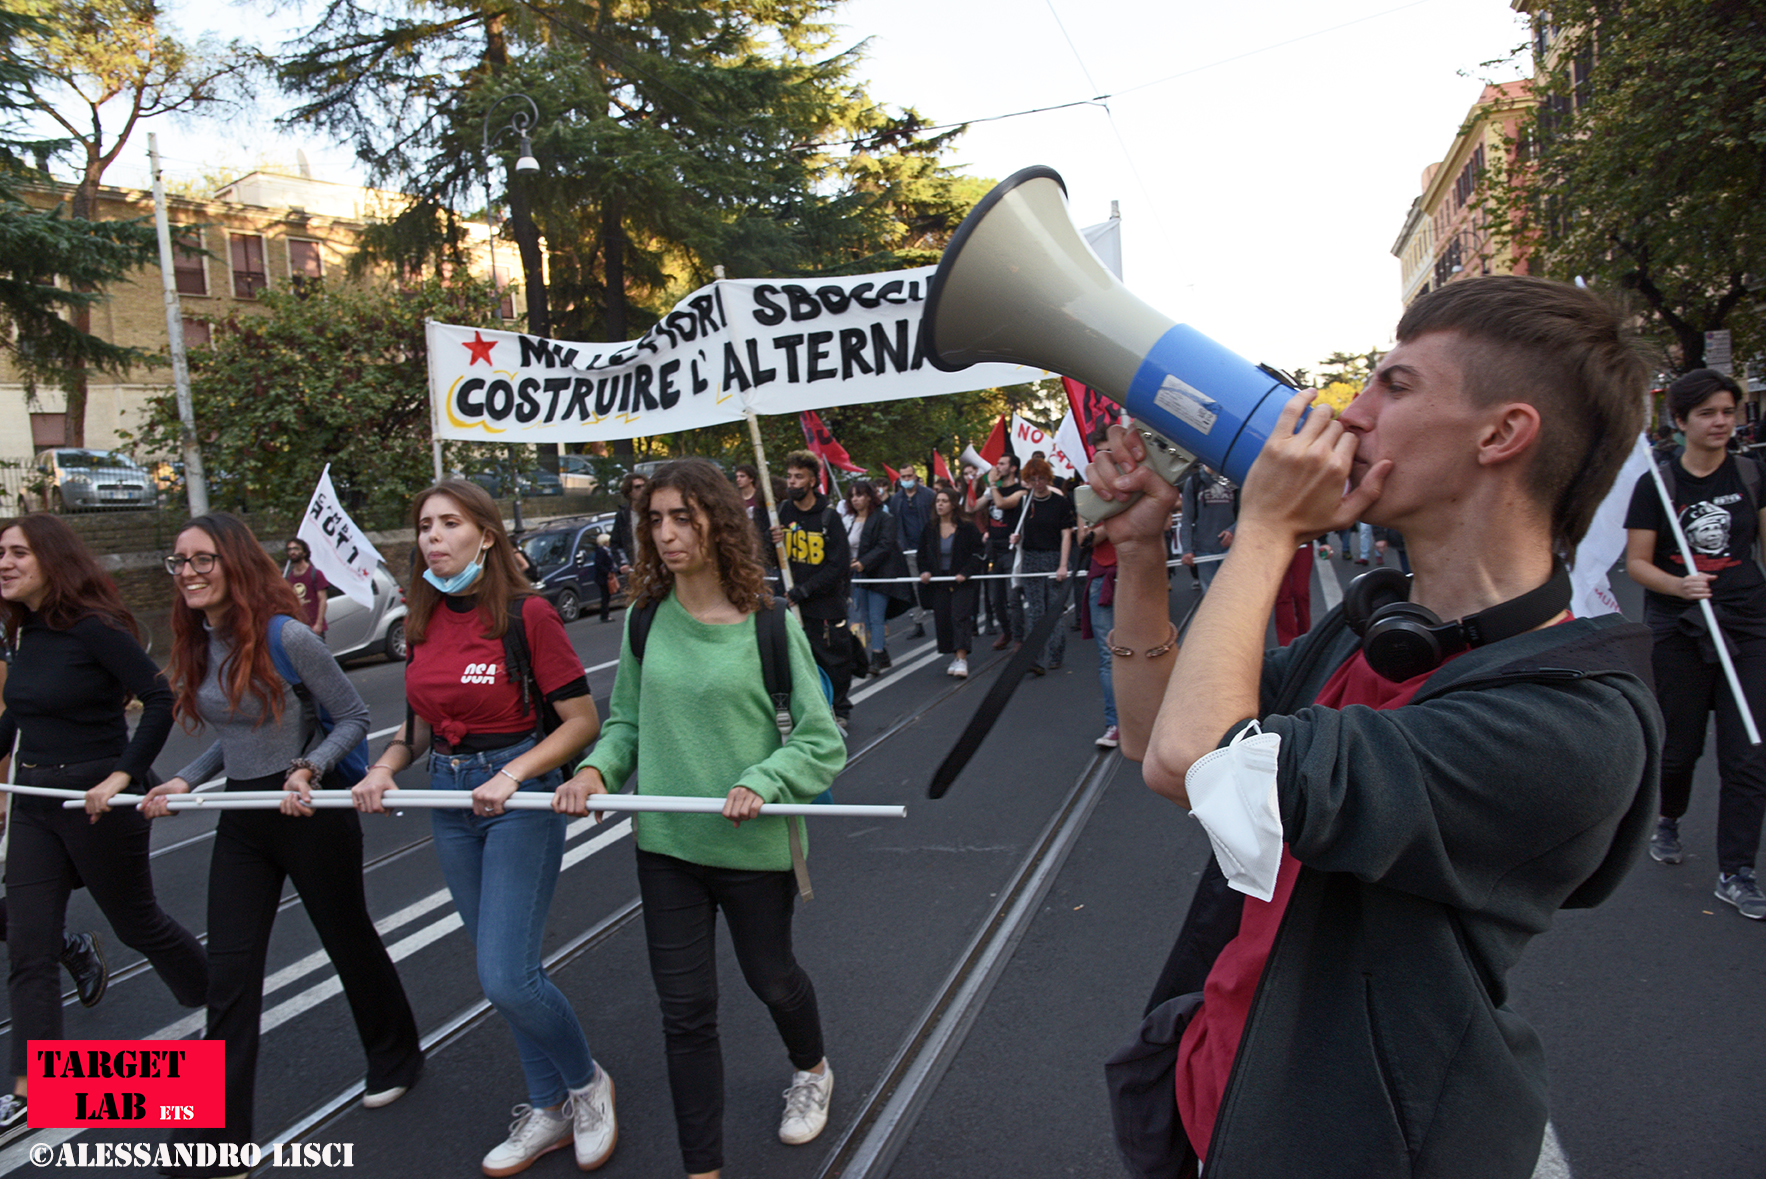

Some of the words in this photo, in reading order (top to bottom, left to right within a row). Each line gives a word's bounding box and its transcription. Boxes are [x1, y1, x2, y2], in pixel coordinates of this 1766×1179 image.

[752, 277, 933, 327] SBOCCI
[456, 358, 682, 424] COSTRUIRE
[1017, 422, 1045, 445] NO
